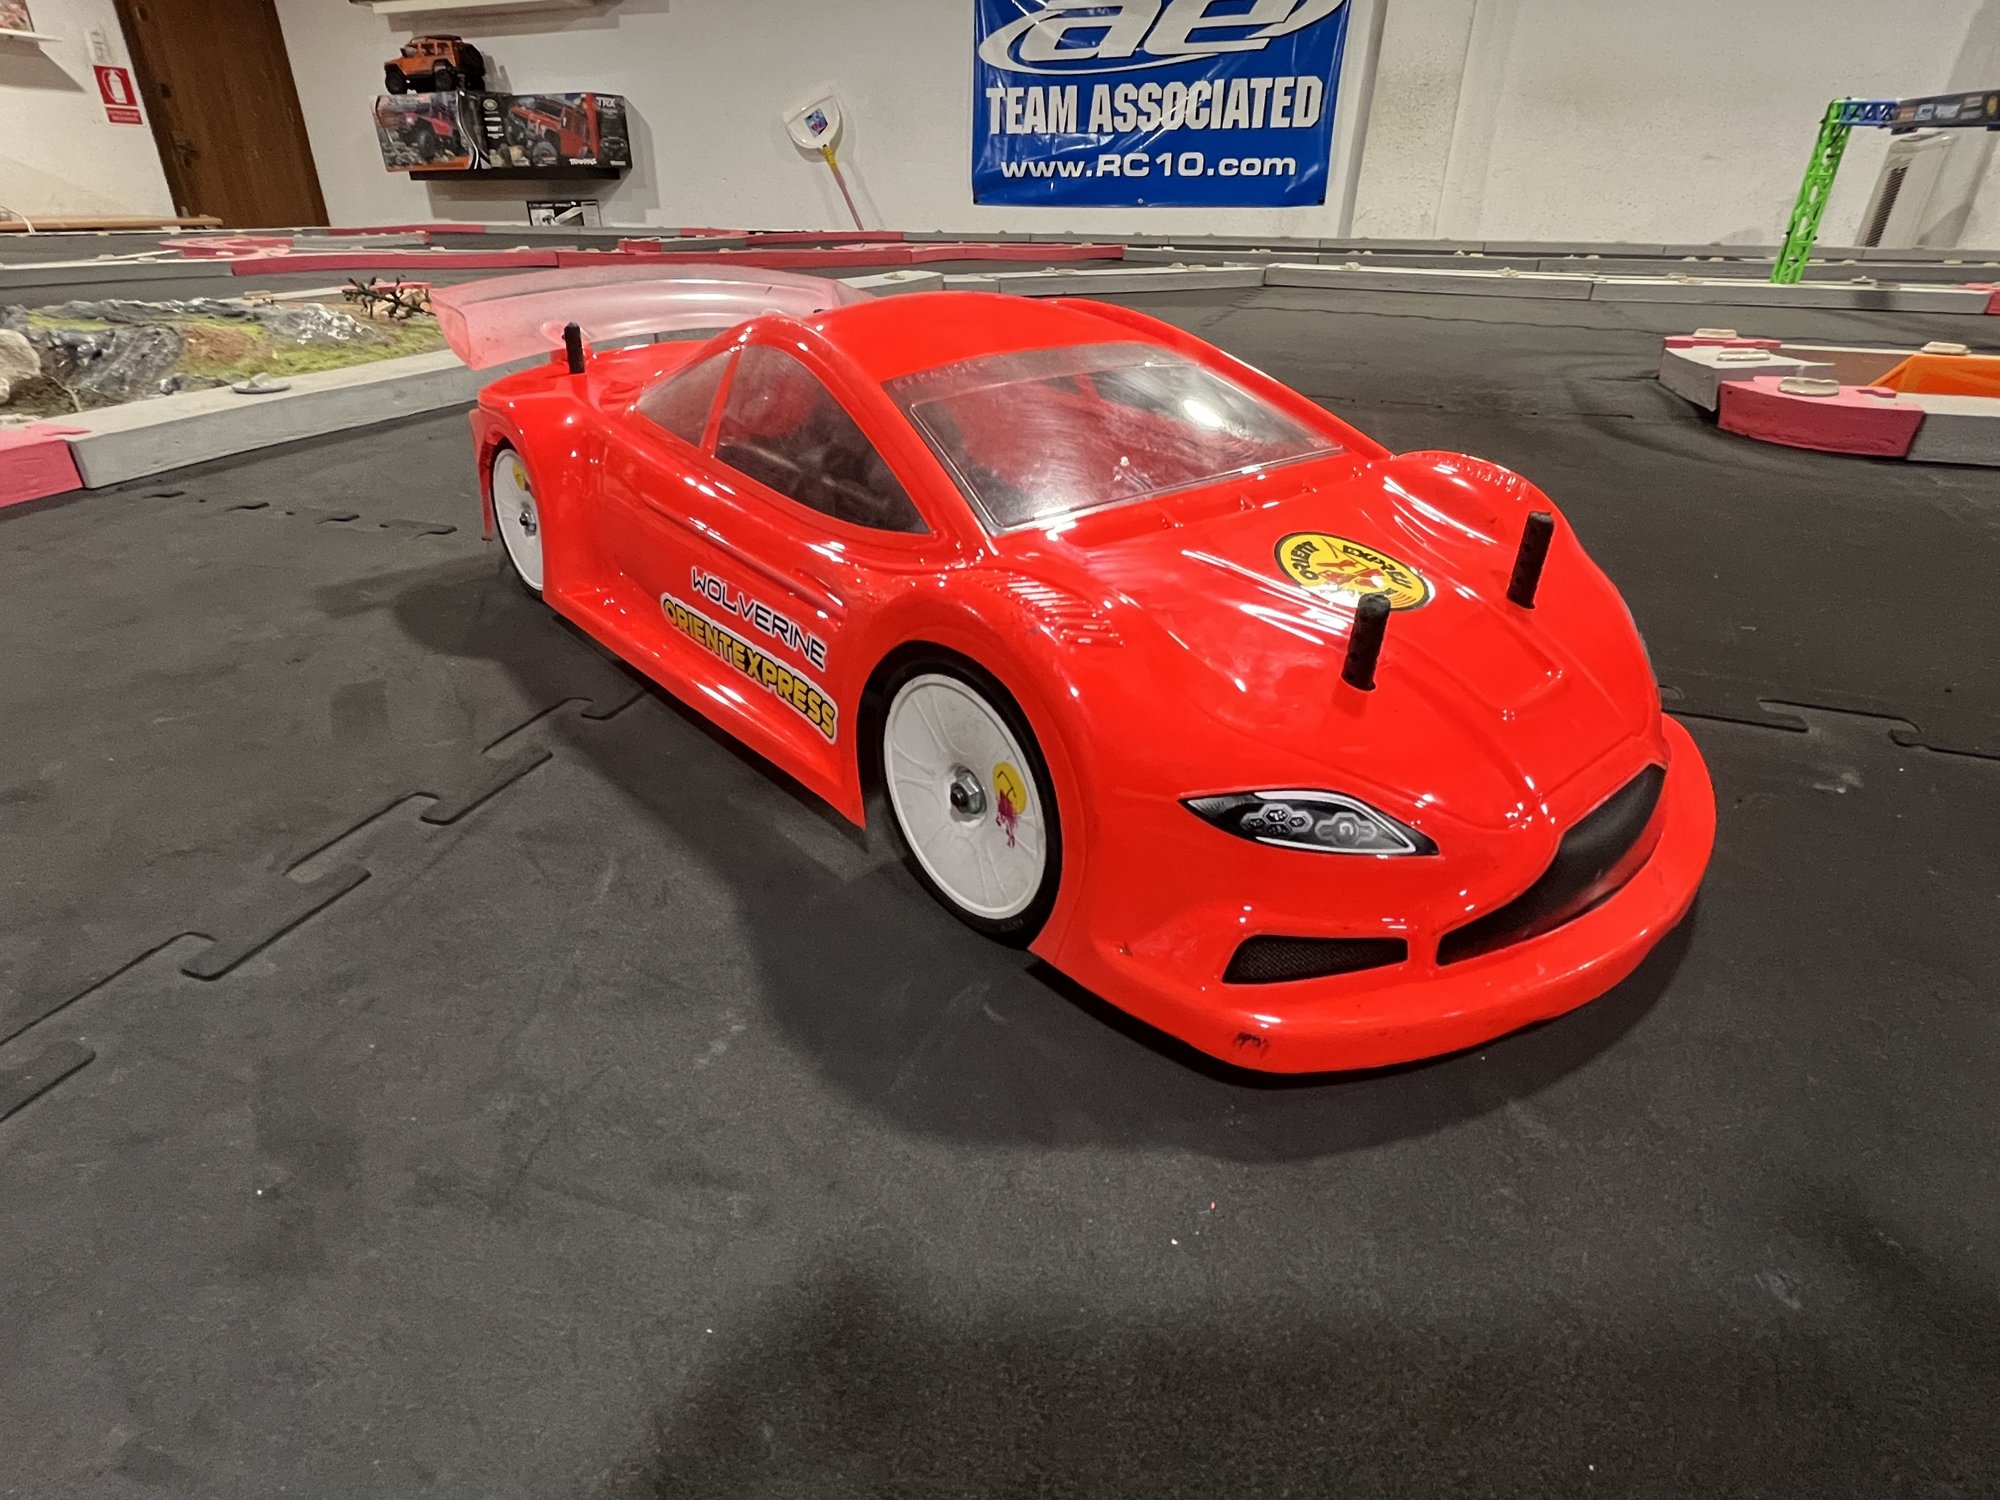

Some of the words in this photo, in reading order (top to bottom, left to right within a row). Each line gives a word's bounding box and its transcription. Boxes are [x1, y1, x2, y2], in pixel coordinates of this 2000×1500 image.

[986, 85, 1078, 134] TEAM
[1088, 76, 1323, 133] ASSOCIATED
[1000, 151, 1297, 178] www.RC10.com
[692, 568, 827, 671] WOLVERINE
[662, 596, 837, 740] ORIENTEXPRESS
